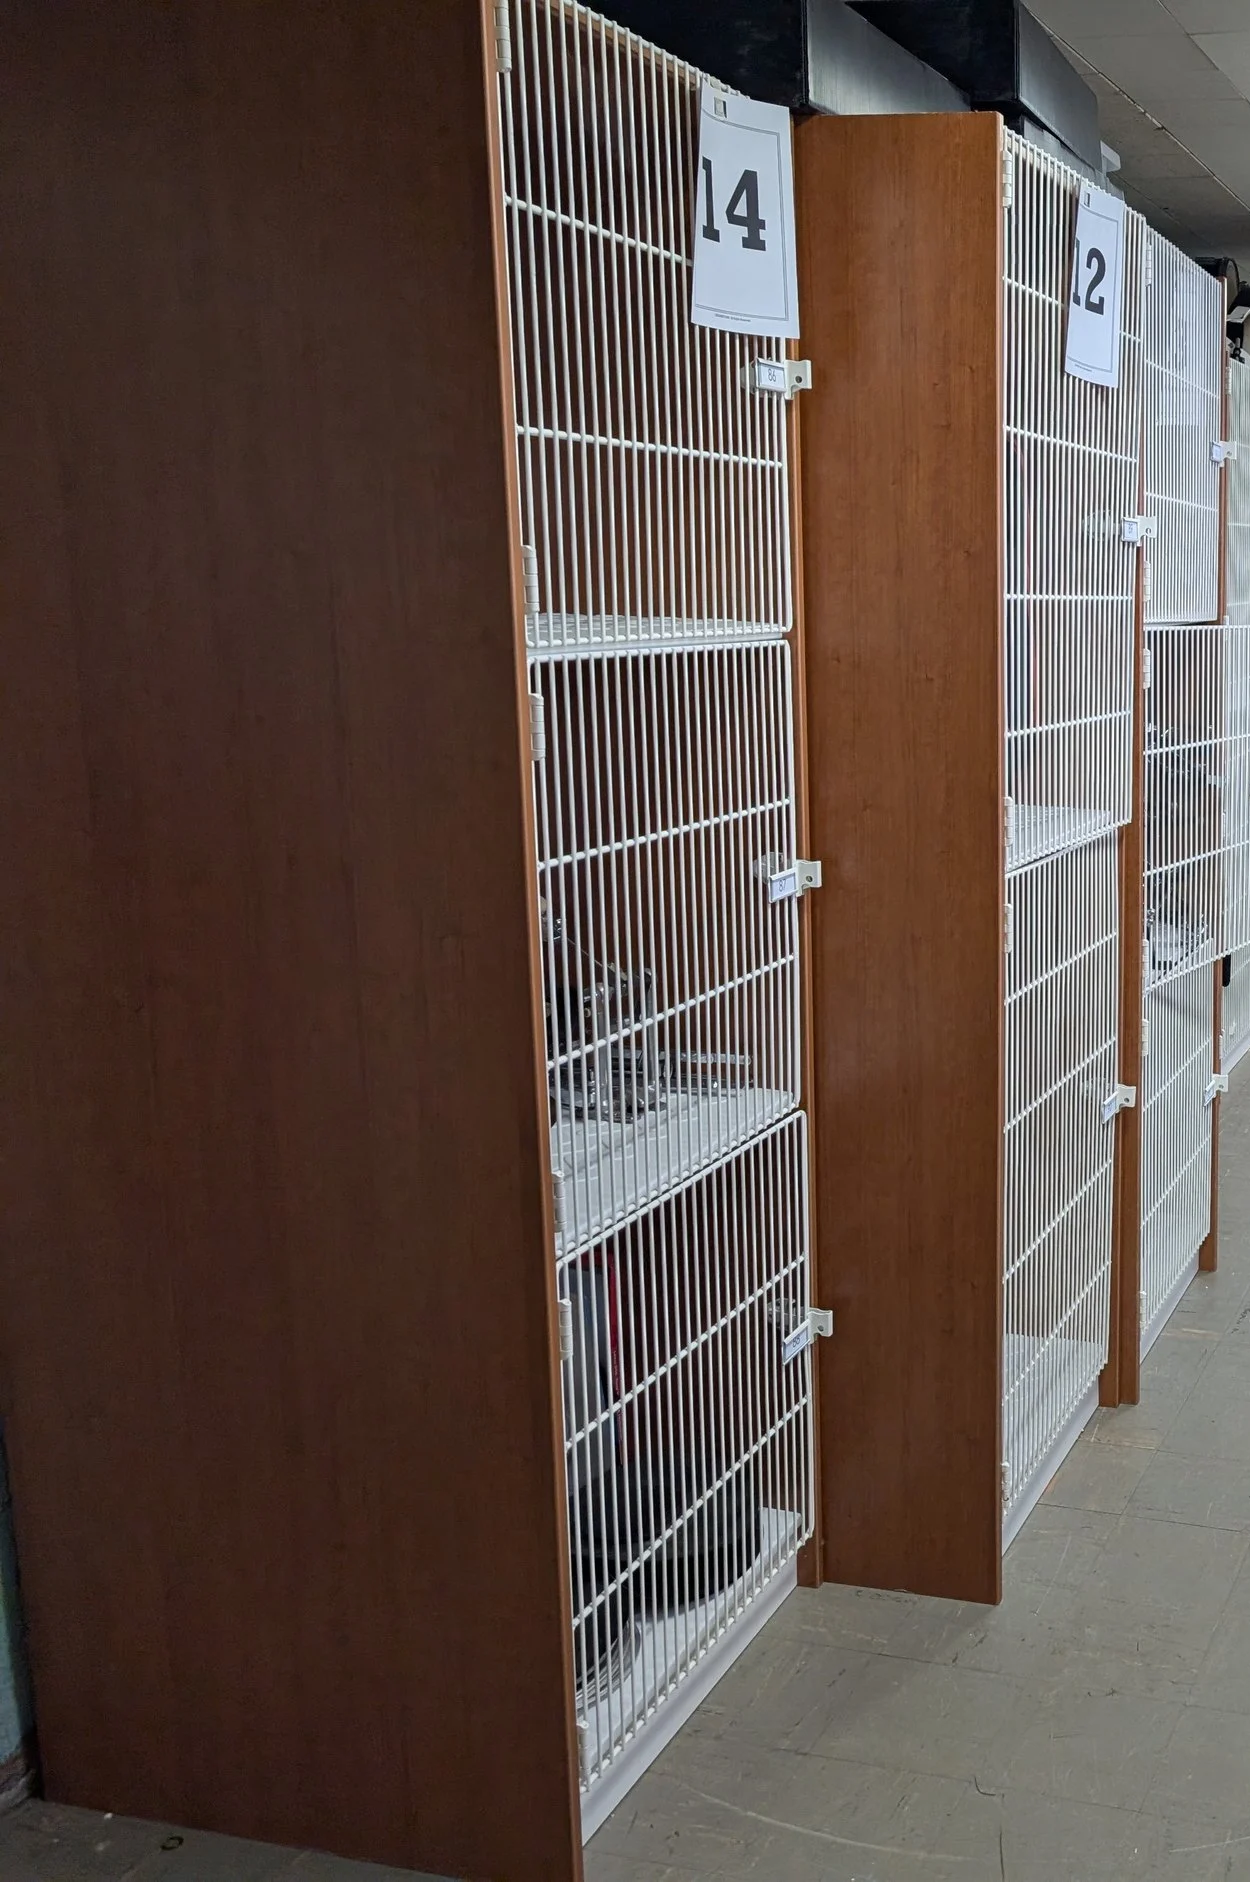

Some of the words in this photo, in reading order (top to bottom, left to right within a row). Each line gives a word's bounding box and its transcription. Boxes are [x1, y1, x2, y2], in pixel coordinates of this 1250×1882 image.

[702, 156, 767, 252] 14
[1072, 237, 1106, 316] 12
[767, 368, 777, 382] 86
[779, 878, 787, 892] 87
